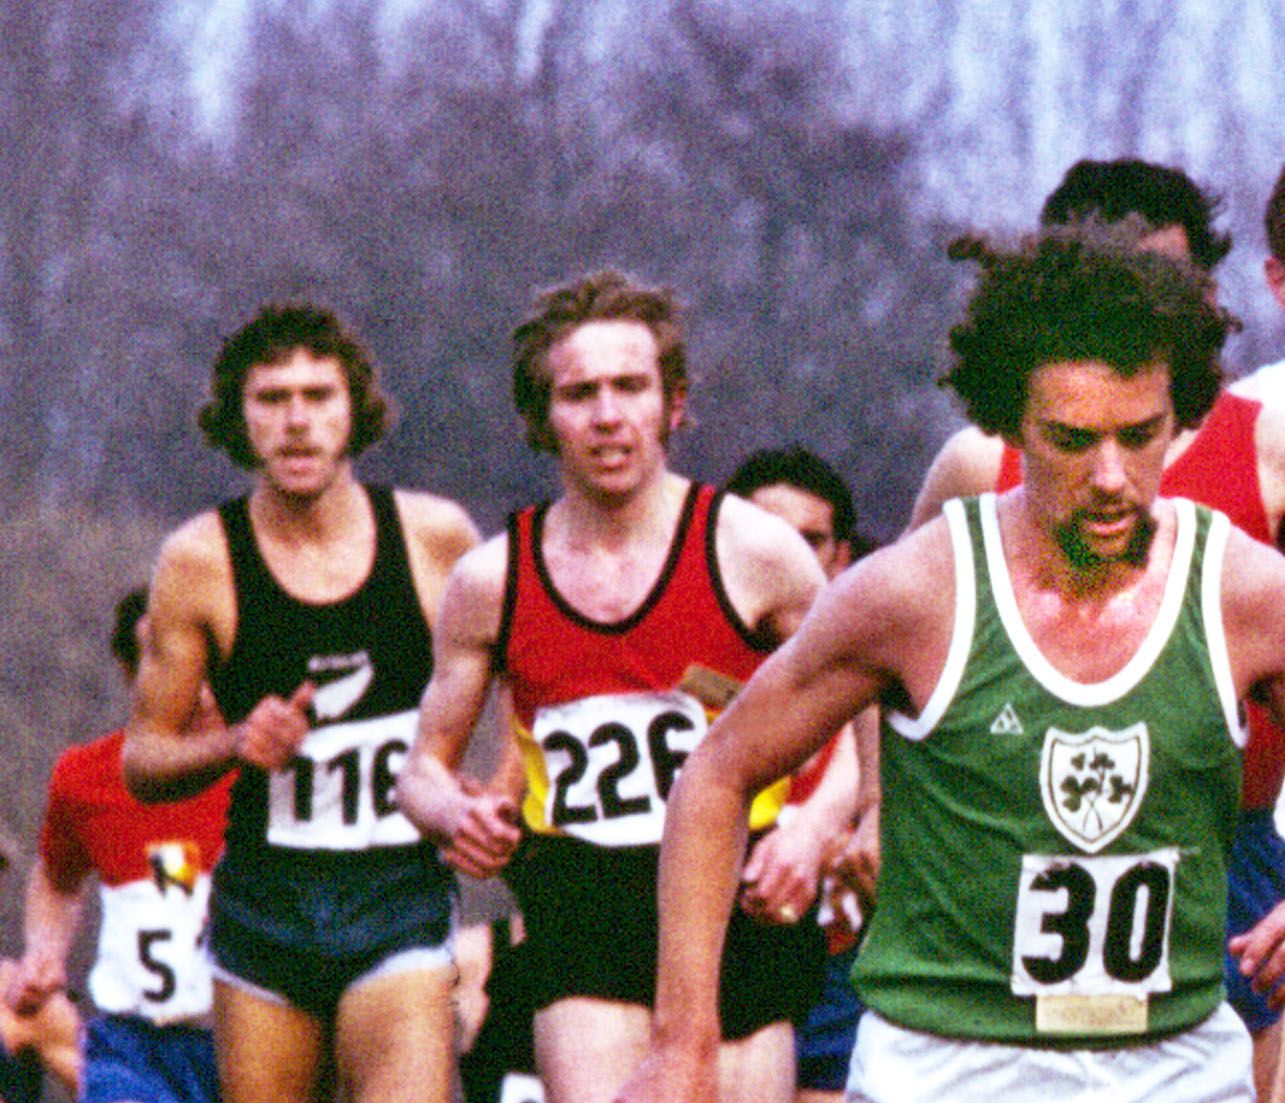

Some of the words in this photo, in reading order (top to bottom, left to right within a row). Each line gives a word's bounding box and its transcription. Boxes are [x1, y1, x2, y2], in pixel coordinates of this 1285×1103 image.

[294, 739, 409, 826] 116
[543, 711, 695, 828] 226
[138, 929, 203, 1003] 5
[1022, 862, 1168, 983] 30
